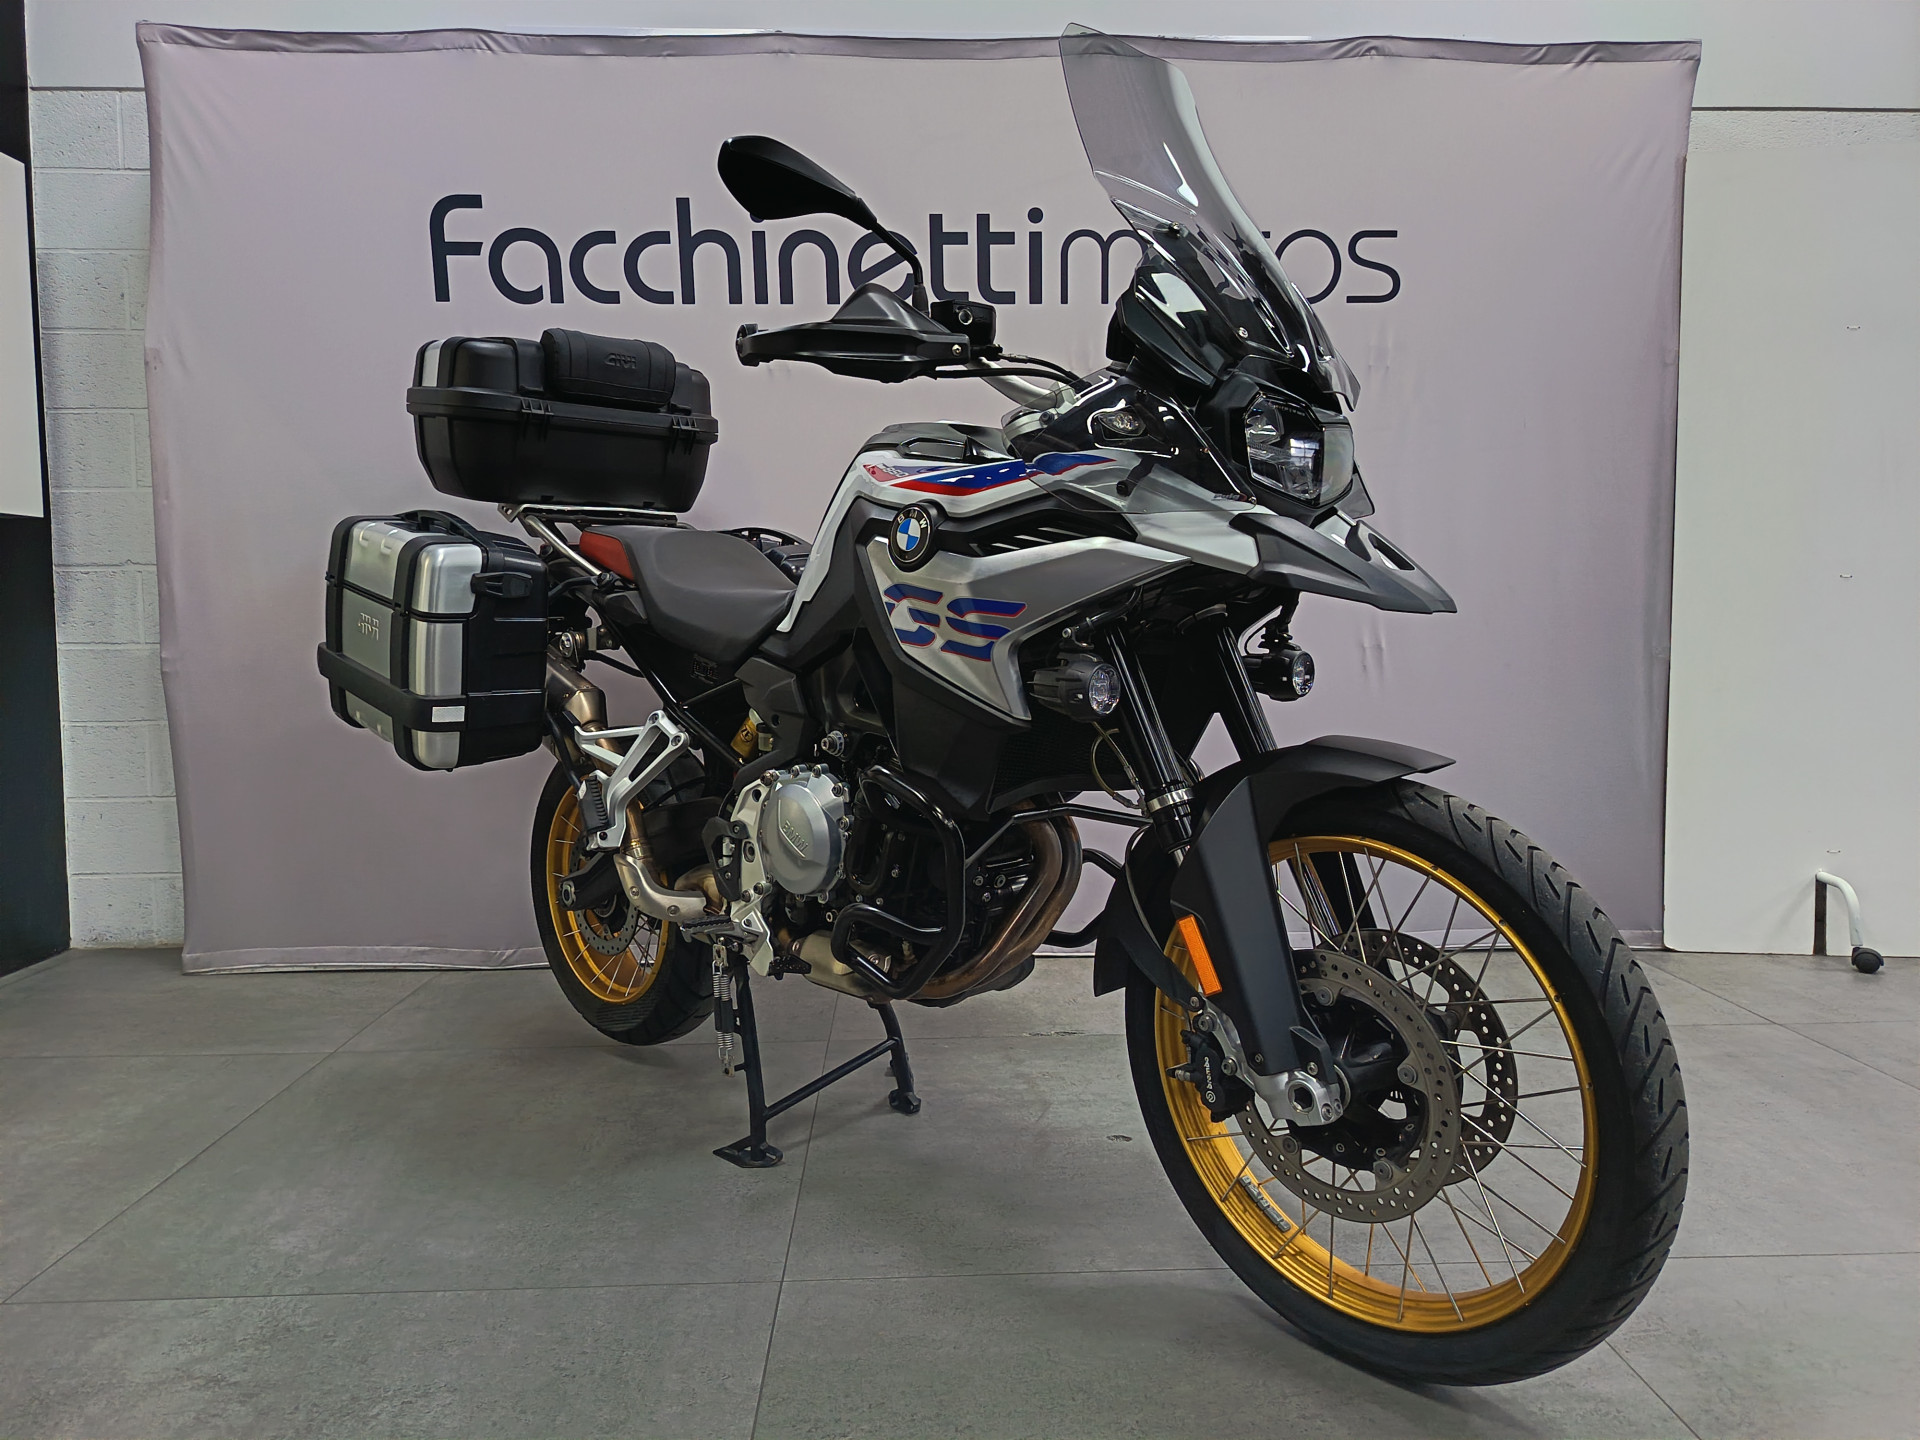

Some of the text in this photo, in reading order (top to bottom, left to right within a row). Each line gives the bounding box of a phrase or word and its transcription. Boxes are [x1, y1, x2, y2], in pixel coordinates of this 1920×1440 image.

[897, 509, 928, 529] BMW
[884, 583, 1028, 663] GS
[783, 819, 809, 853] BMW
[1204, 1056, 1213, 1090] brembo
